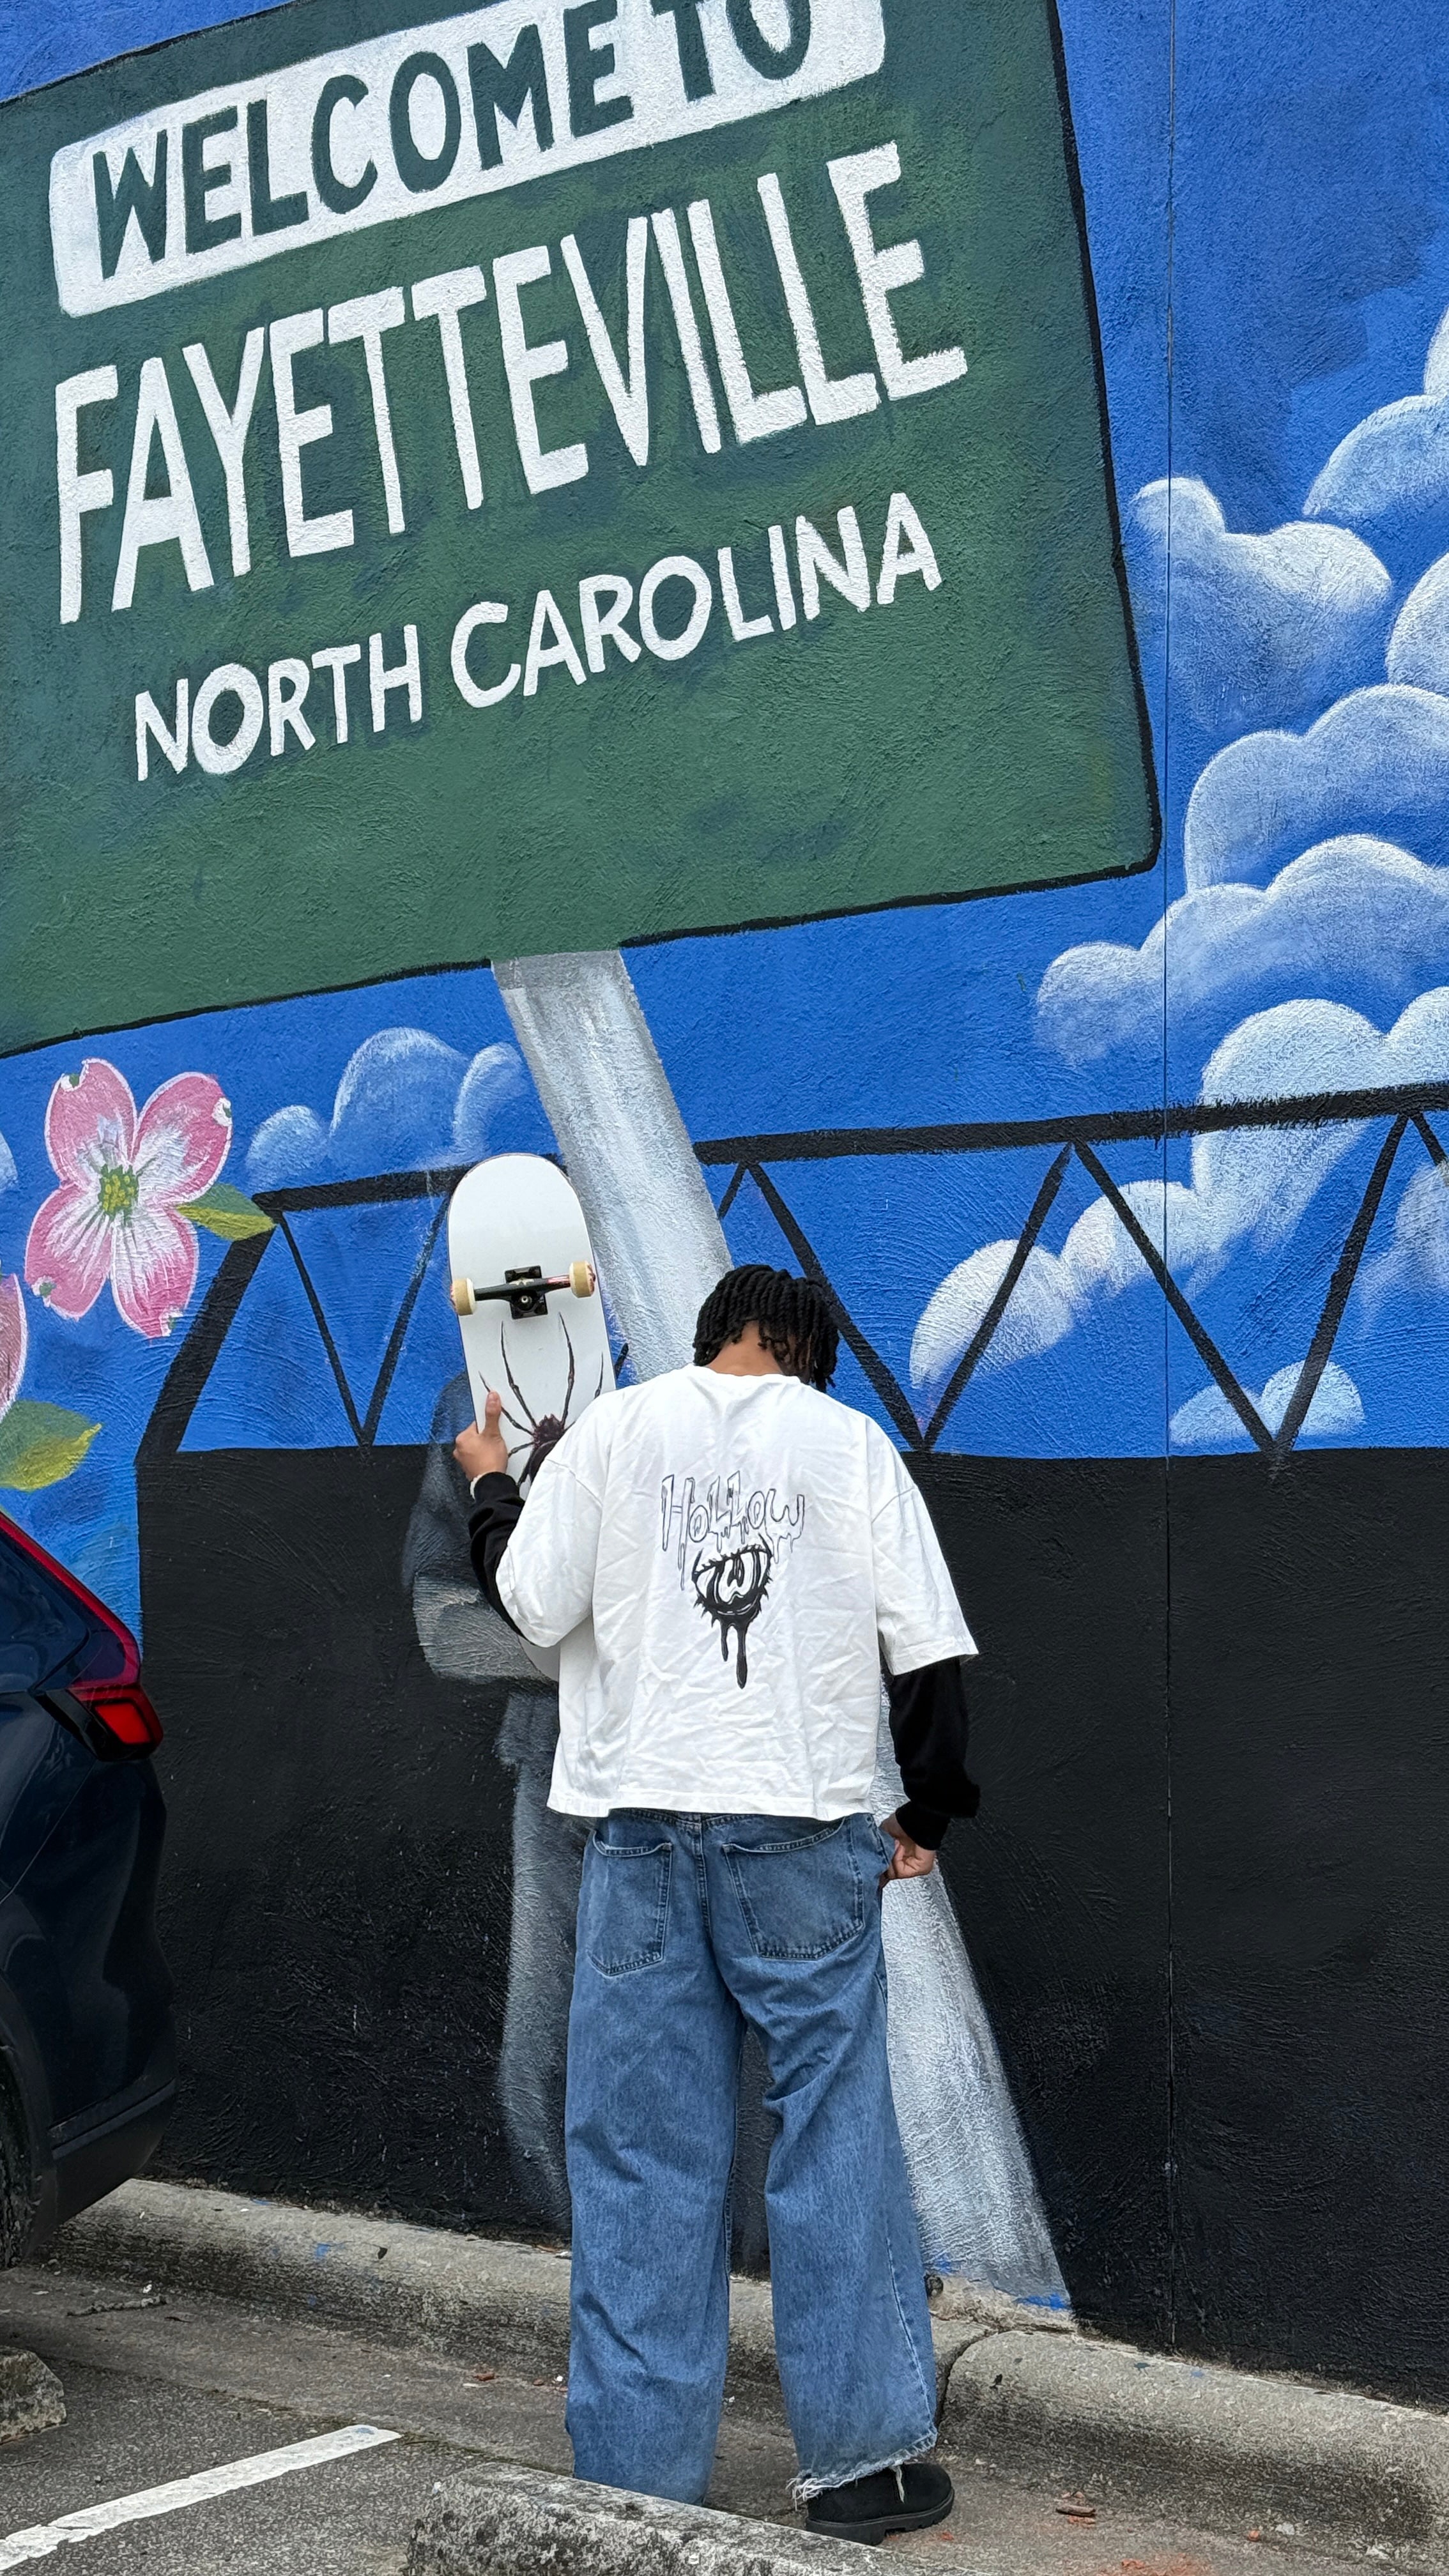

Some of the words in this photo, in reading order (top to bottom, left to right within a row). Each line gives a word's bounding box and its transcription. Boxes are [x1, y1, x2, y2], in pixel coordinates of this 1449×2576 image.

[93, 0, 634, 280] WELCOME
[650, 0, 811, 102] TO
[57, 141, 968, 625] FAYETTEVILLE
[134, 627, 422, 780] NORTH
[450, 492, 940, 709] CAROLINA
